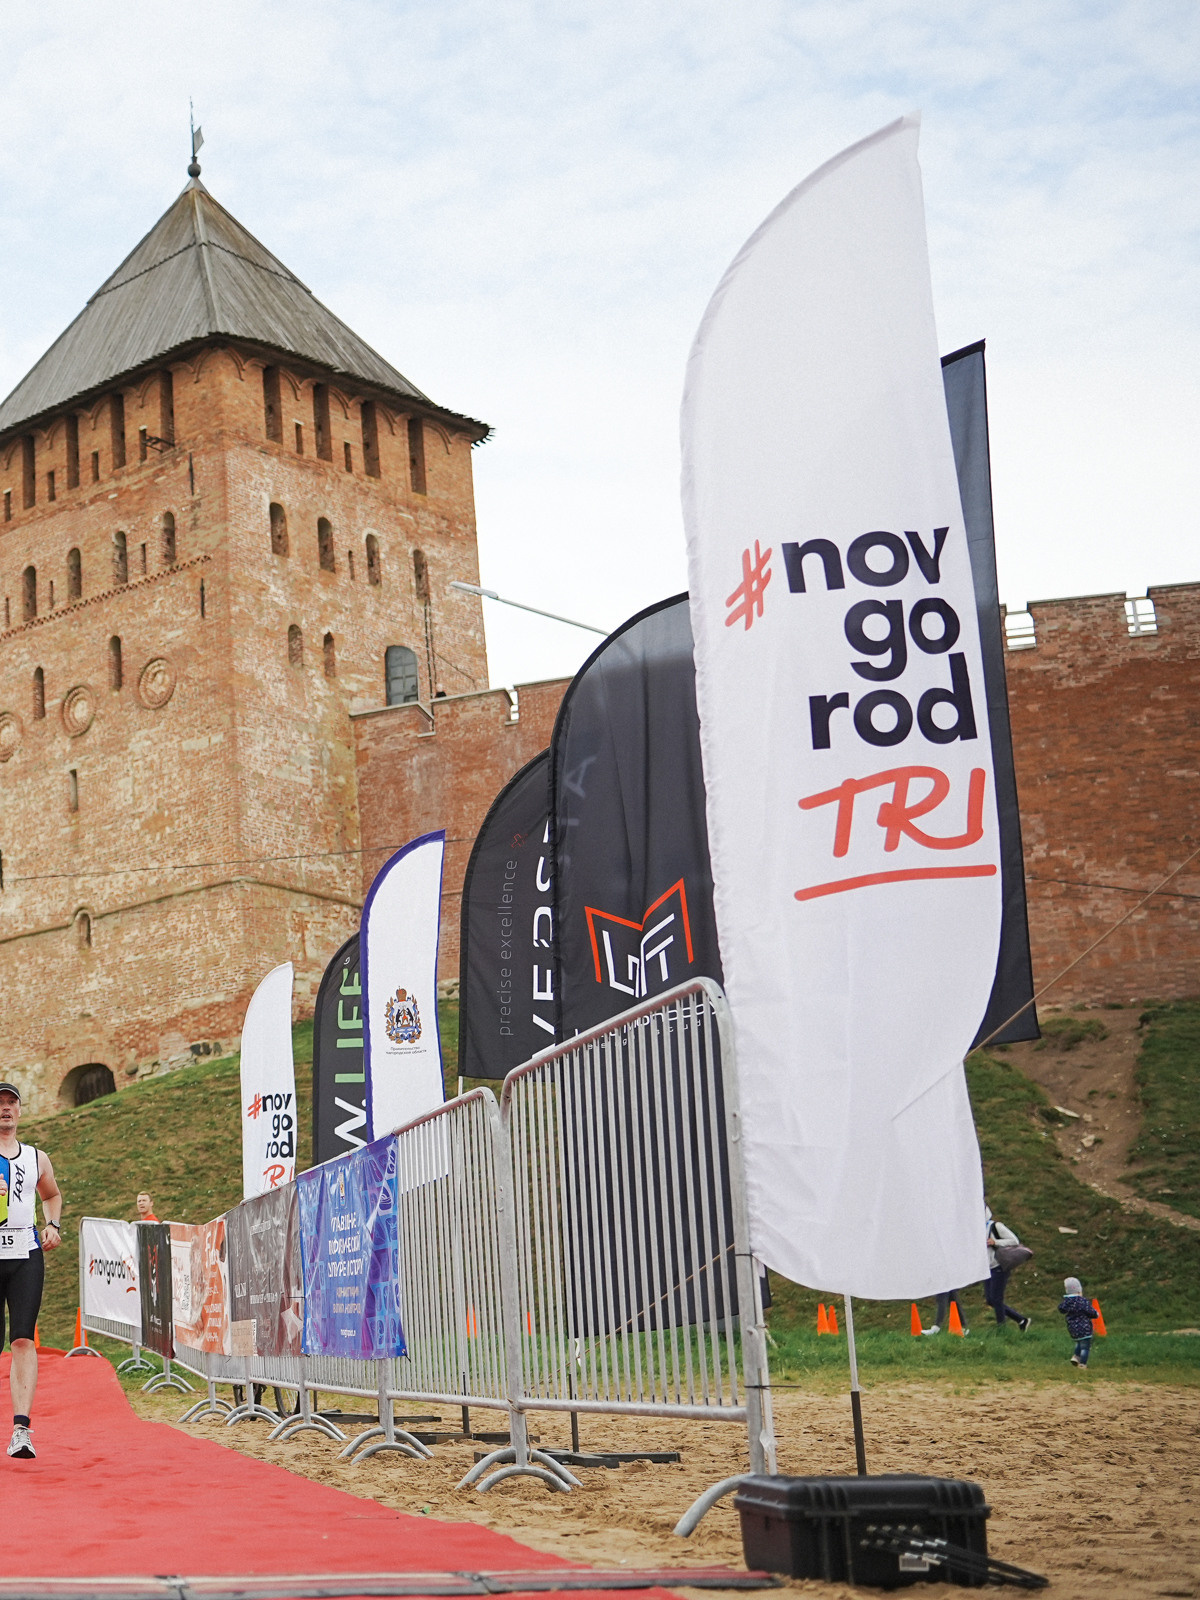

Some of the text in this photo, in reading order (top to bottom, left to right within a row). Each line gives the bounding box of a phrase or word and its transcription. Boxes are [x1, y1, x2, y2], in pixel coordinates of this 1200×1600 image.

[725, 526, 949, 631] #nov
[844, 597, 960, 682] go
[808, 652, 978, 750] rod
[798, 765, 986, 858] TRI
[497, 859, 518, 1036] precise excellence
[248, 1092, 292, 1120] #nov
[266, 1131, 294, 1158] rod
[272, 1114, 293, 1138] go
[1, 1235, 14, 1246] 15
